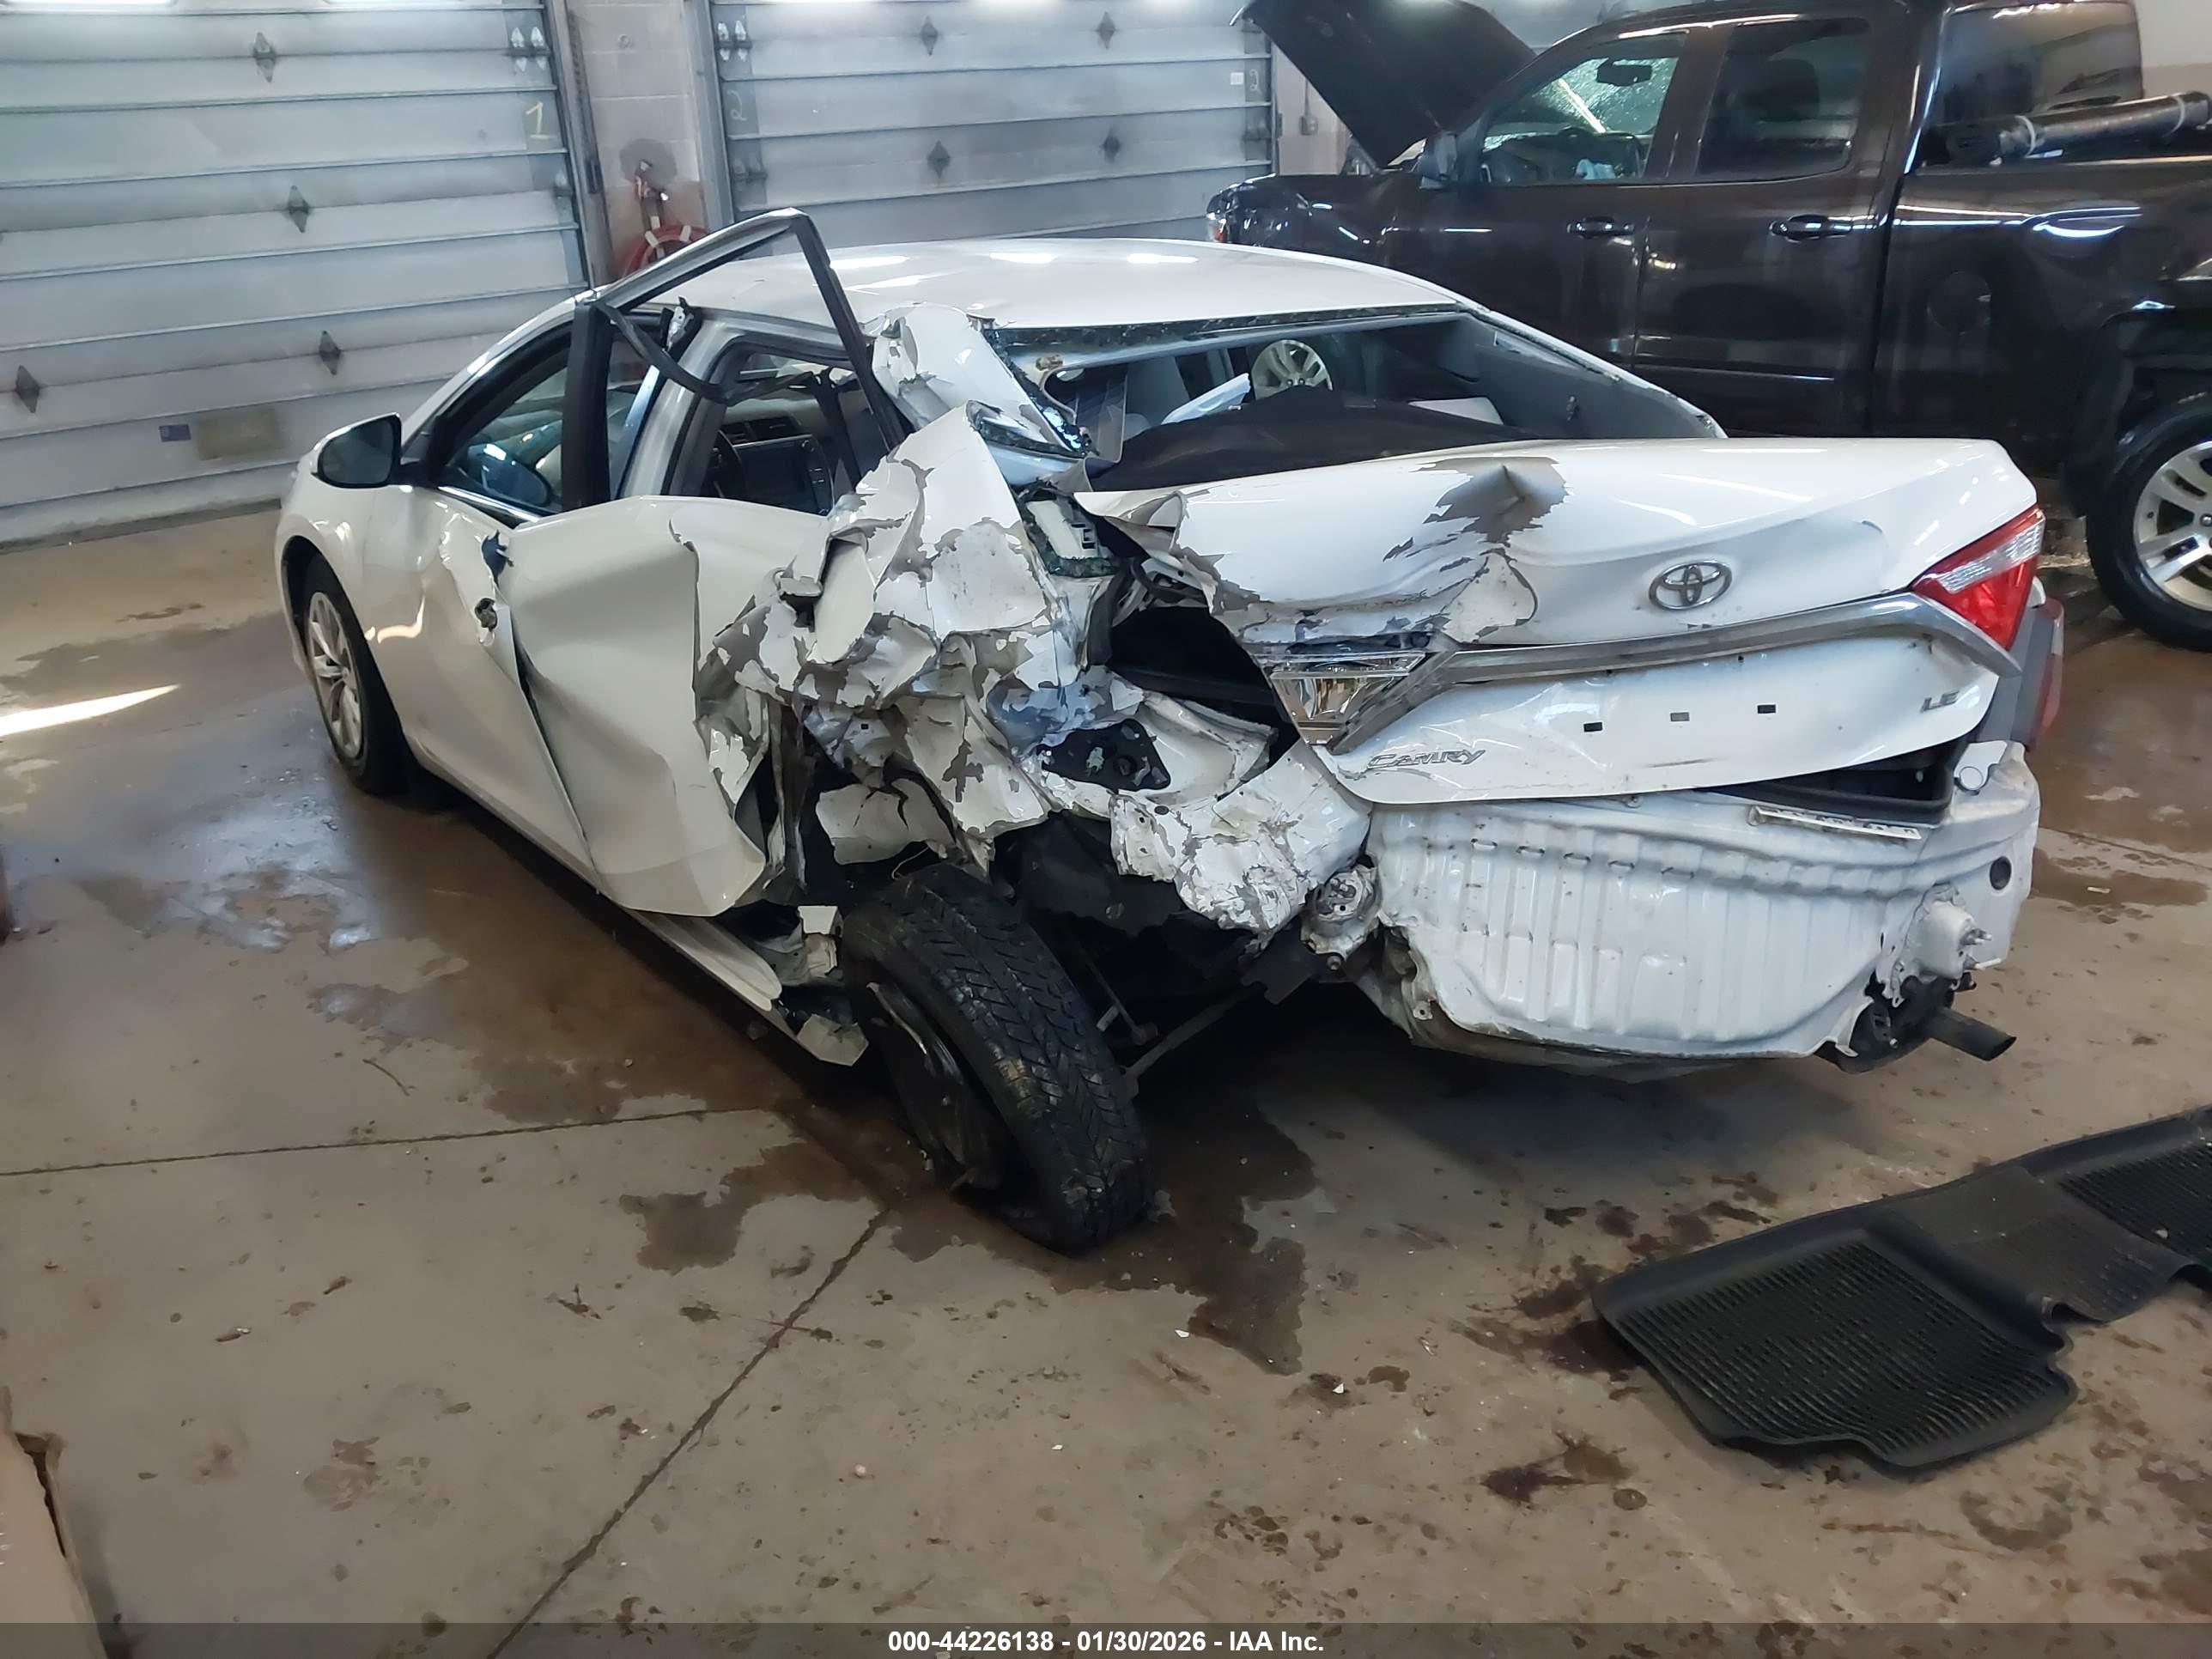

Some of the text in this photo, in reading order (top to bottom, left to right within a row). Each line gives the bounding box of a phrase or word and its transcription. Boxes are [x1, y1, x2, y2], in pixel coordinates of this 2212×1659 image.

[728, 89, 747, 121] 2
[526, 101, 556, 138] 1
[1919, 690, 1960, 714] LE
[1367, 749, 1486, 769] CAMRY
